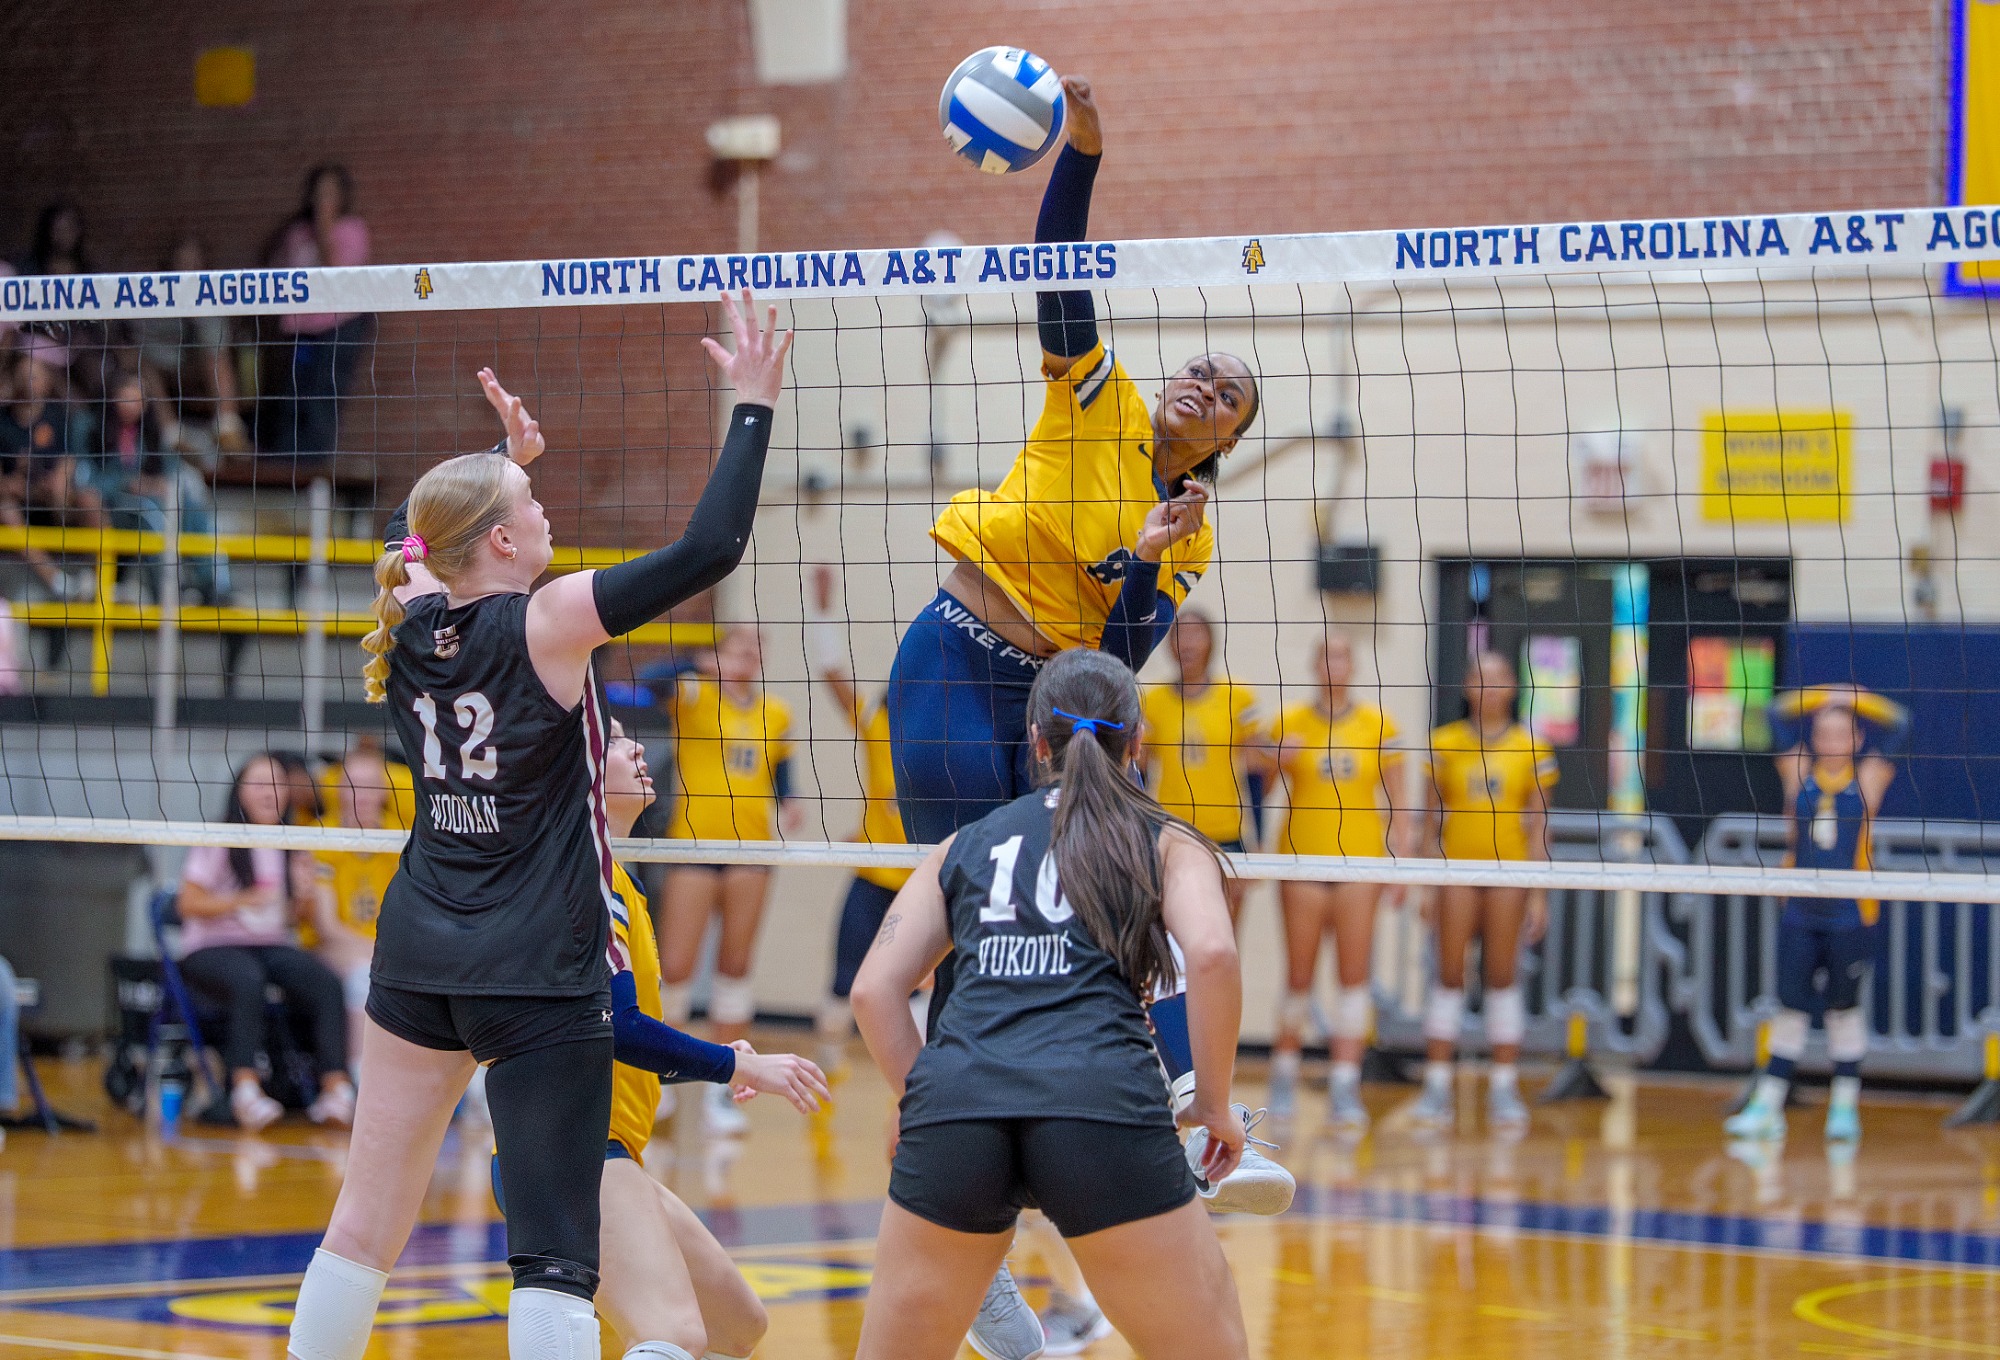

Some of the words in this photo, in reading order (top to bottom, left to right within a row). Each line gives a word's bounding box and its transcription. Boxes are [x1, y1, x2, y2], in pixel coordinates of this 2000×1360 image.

[1396, 226, 1540, 270] NORTH
[1559, 218, 1789, 263] CAROLINA
[1809, 213, 1904, 255] A&T
[0, 278, 100, 312] OLINA
[114, 276, 180, 308] A&T
[195, 271, 309, 306] AGGIES
[542, 258, 660, 297] NORTH
[678, 250, 865, 292] CAROLINA
[883, 248, 962, 285] A&T
[979, 243, 1117, 283] AGGIES
[935, 599, 1003, 650] NIKE
[413, 691, 498, 780] 12
[429, 793, 500, 834] NOONAN
